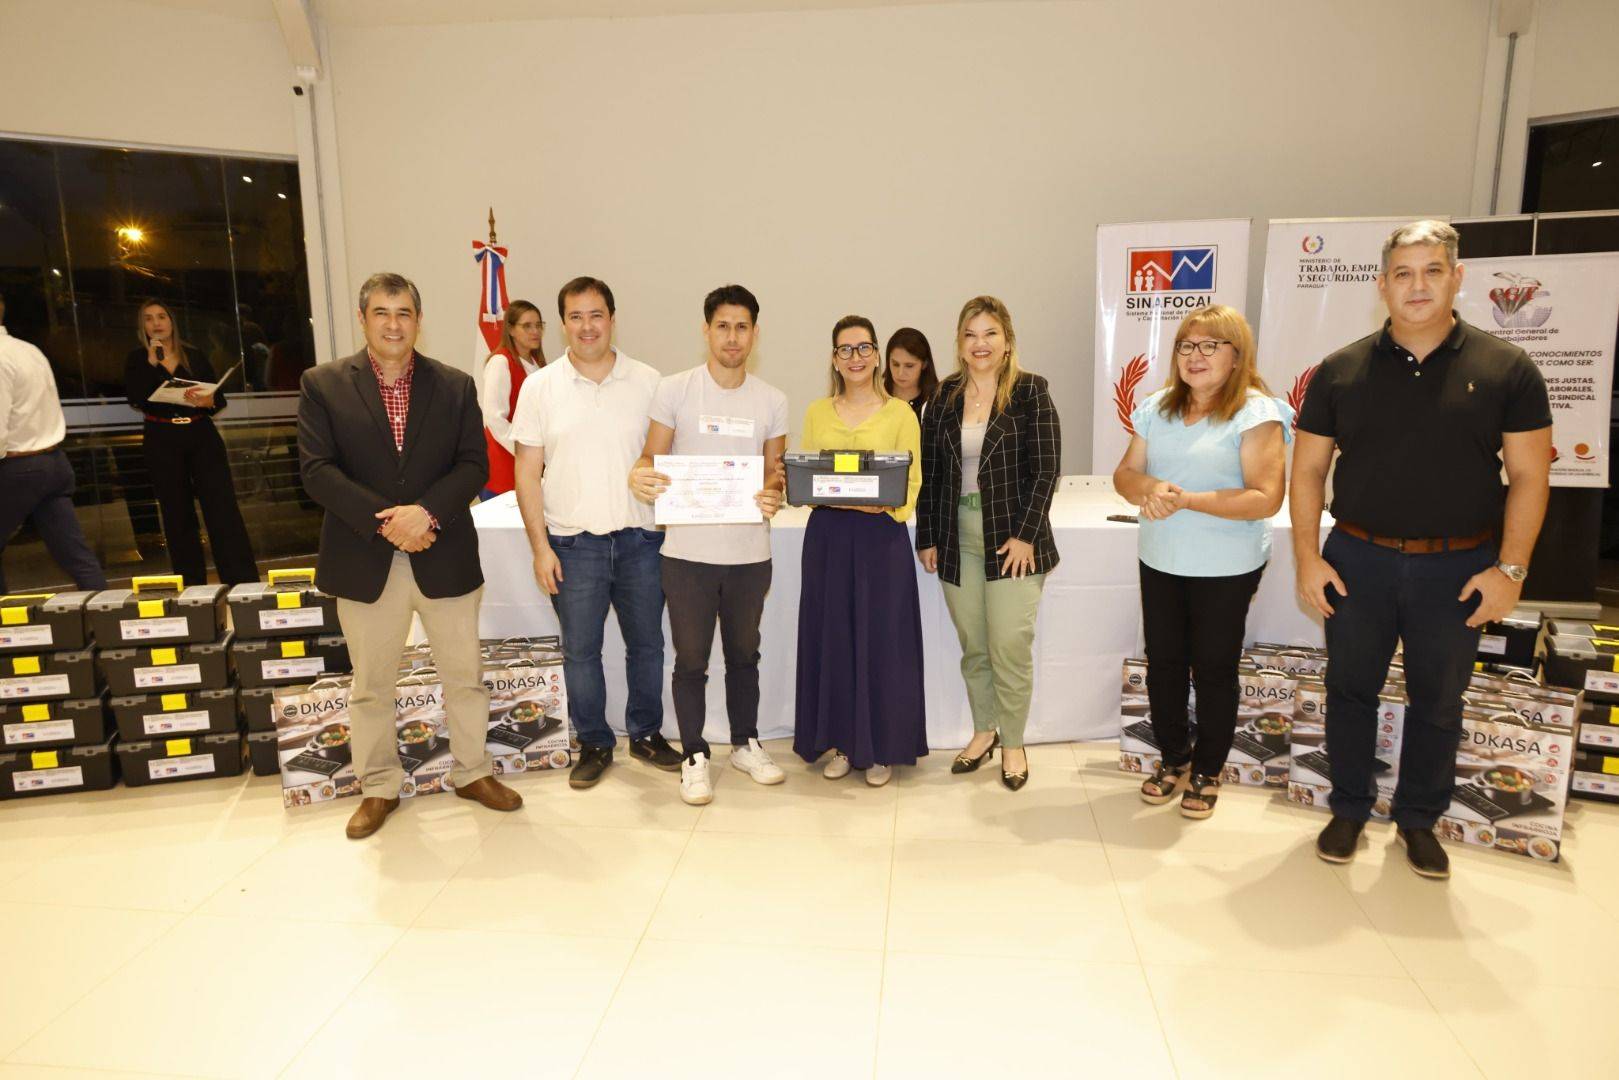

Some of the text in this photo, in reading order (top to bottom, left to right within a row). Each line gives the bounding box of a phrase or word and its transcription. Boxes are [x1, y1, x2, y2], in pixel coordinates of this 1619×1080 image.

[1299, 264, 1349, 273] TRABAJO,
[1298, 274, 1305, 282] Y
[1306, 274, 1370, 282] SEGURIDAD
[1528, 350, 1603, 358] CONOCIMIENTOS
[1546, 359, 1574, 367] COMO
[496, 675, 547, 691] DKASA
[300, 698, 349, 715] DKAS
[394, 693, 437, 709] KASA
[1473, 731, 1542, 755] DKASA
